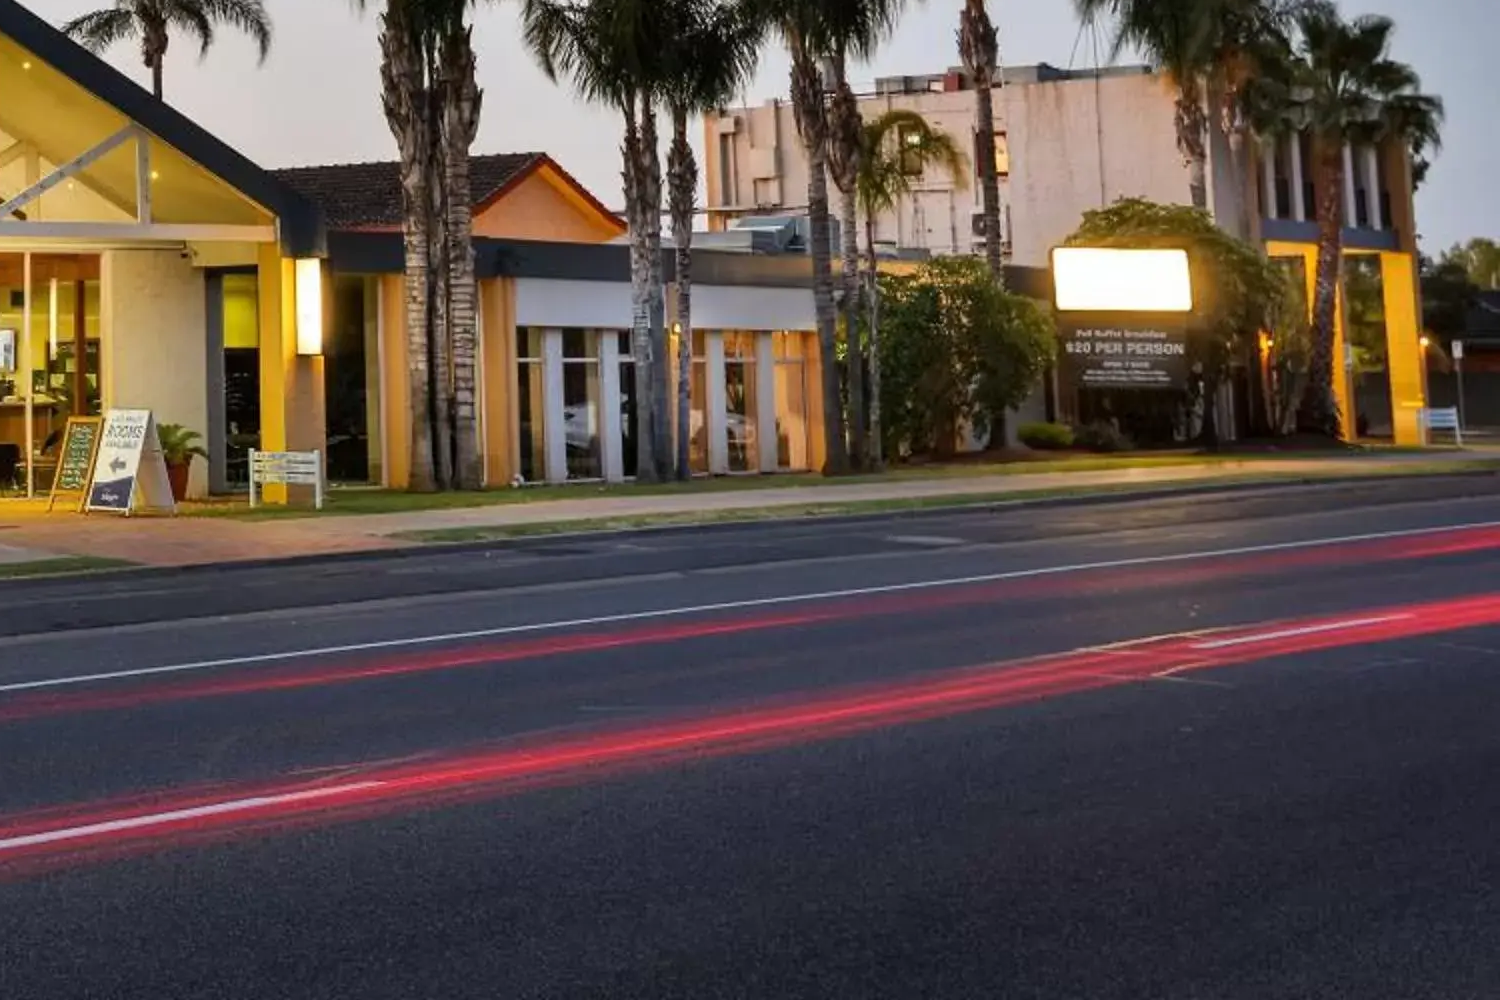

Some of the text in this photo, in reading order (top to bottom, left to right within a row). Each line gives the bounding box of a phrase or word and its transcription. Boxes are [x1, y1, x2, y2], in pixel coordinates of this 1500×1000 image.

[1095, 342, 1123, 354] PER
[1127, 342, 1185, 355] PERSON
[106, 424, 145, 439] ROOMS
